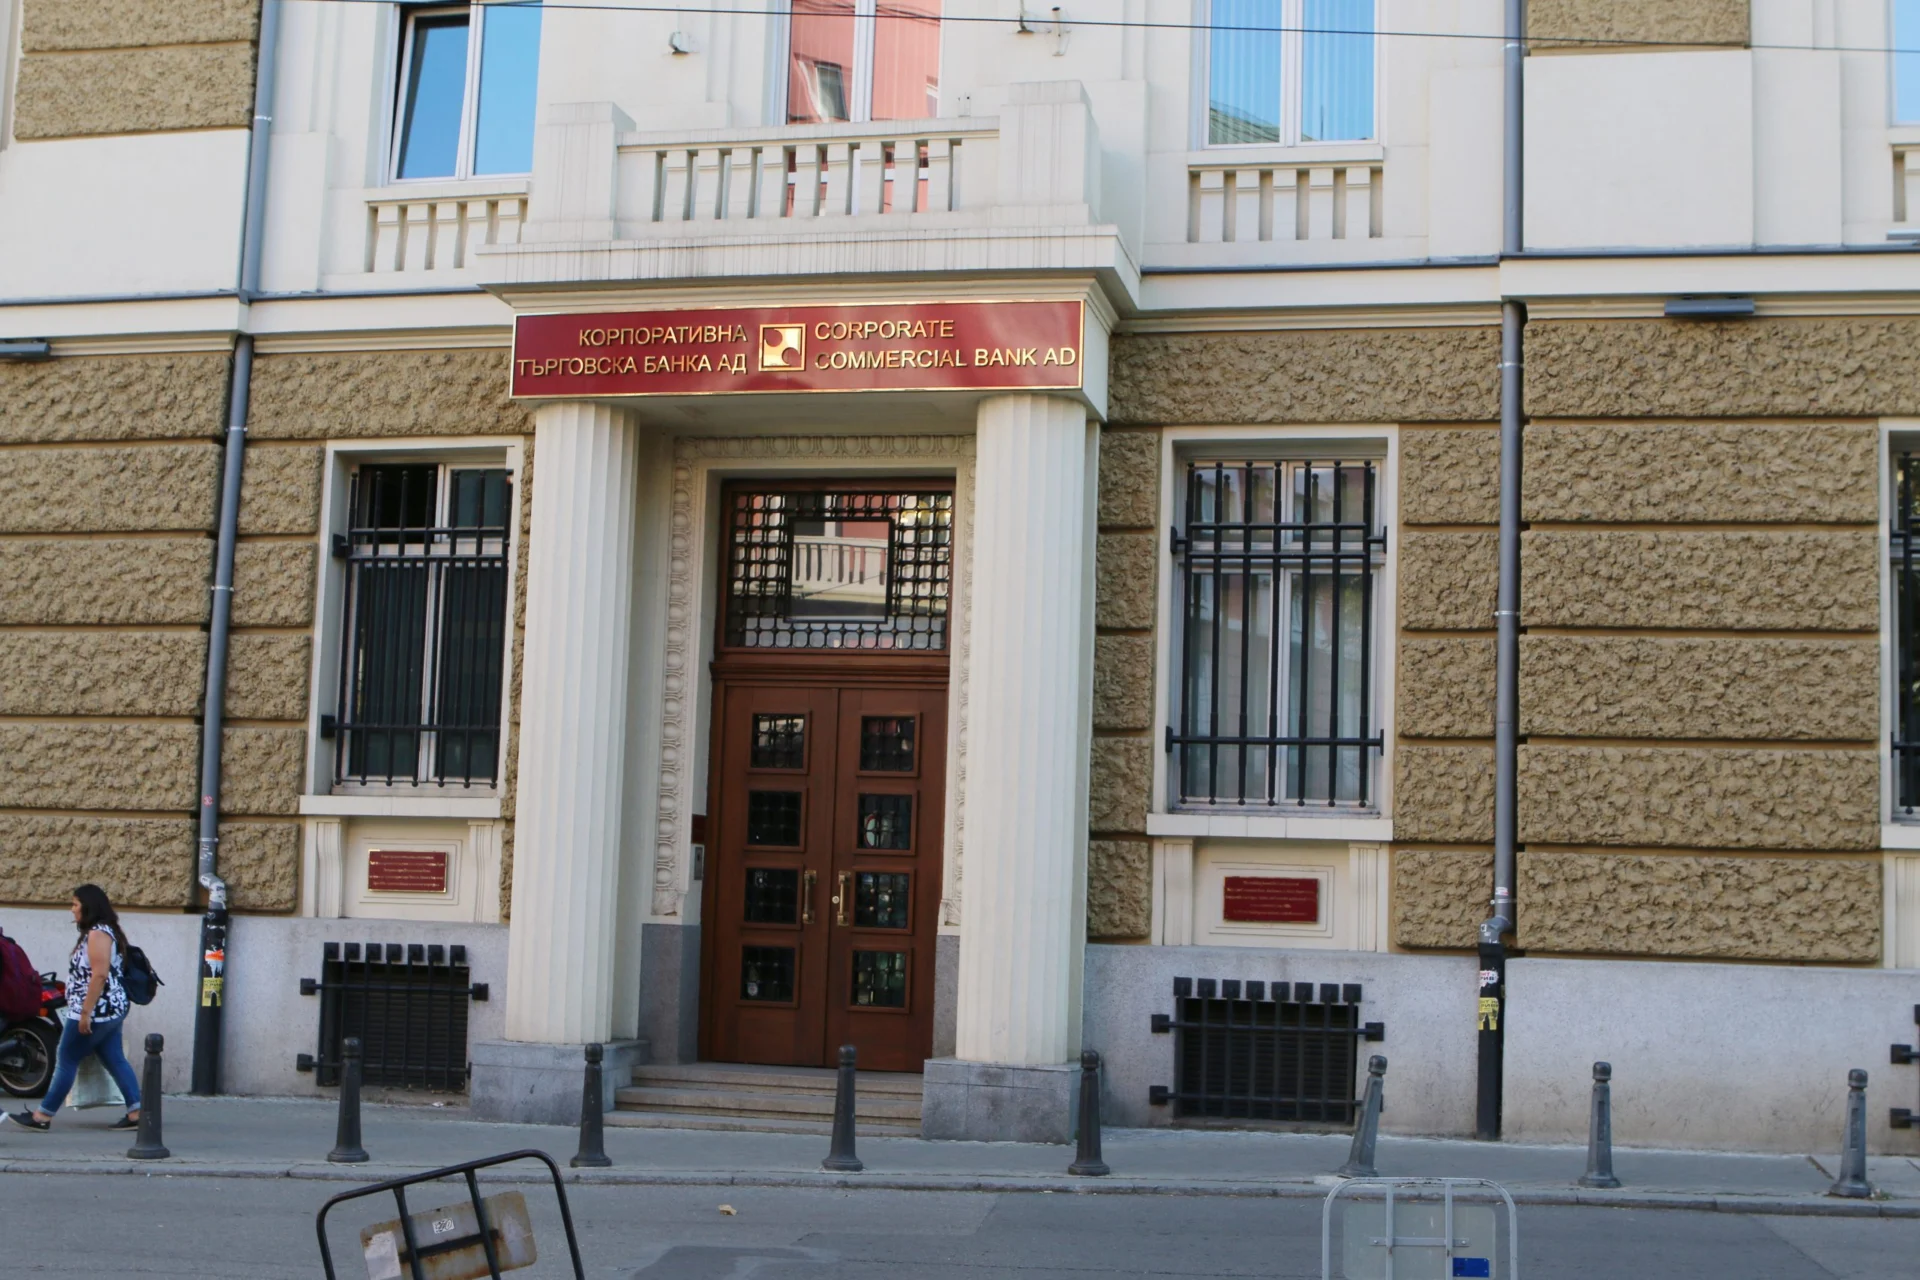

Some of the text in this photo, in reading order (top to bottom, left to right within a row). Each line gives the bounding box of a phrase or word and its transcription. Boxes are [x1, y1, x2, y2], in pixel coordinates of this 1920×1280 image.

[579, 324, 748, 346] КОРПОРАТИВНА
[814, 320, 955, 340] CORPORATE
[517, 353, 748, 376] ТЪРГОВСКА БАНКА АД
[814, 347, 1077, 370] COMMERCIAL BANK AD
